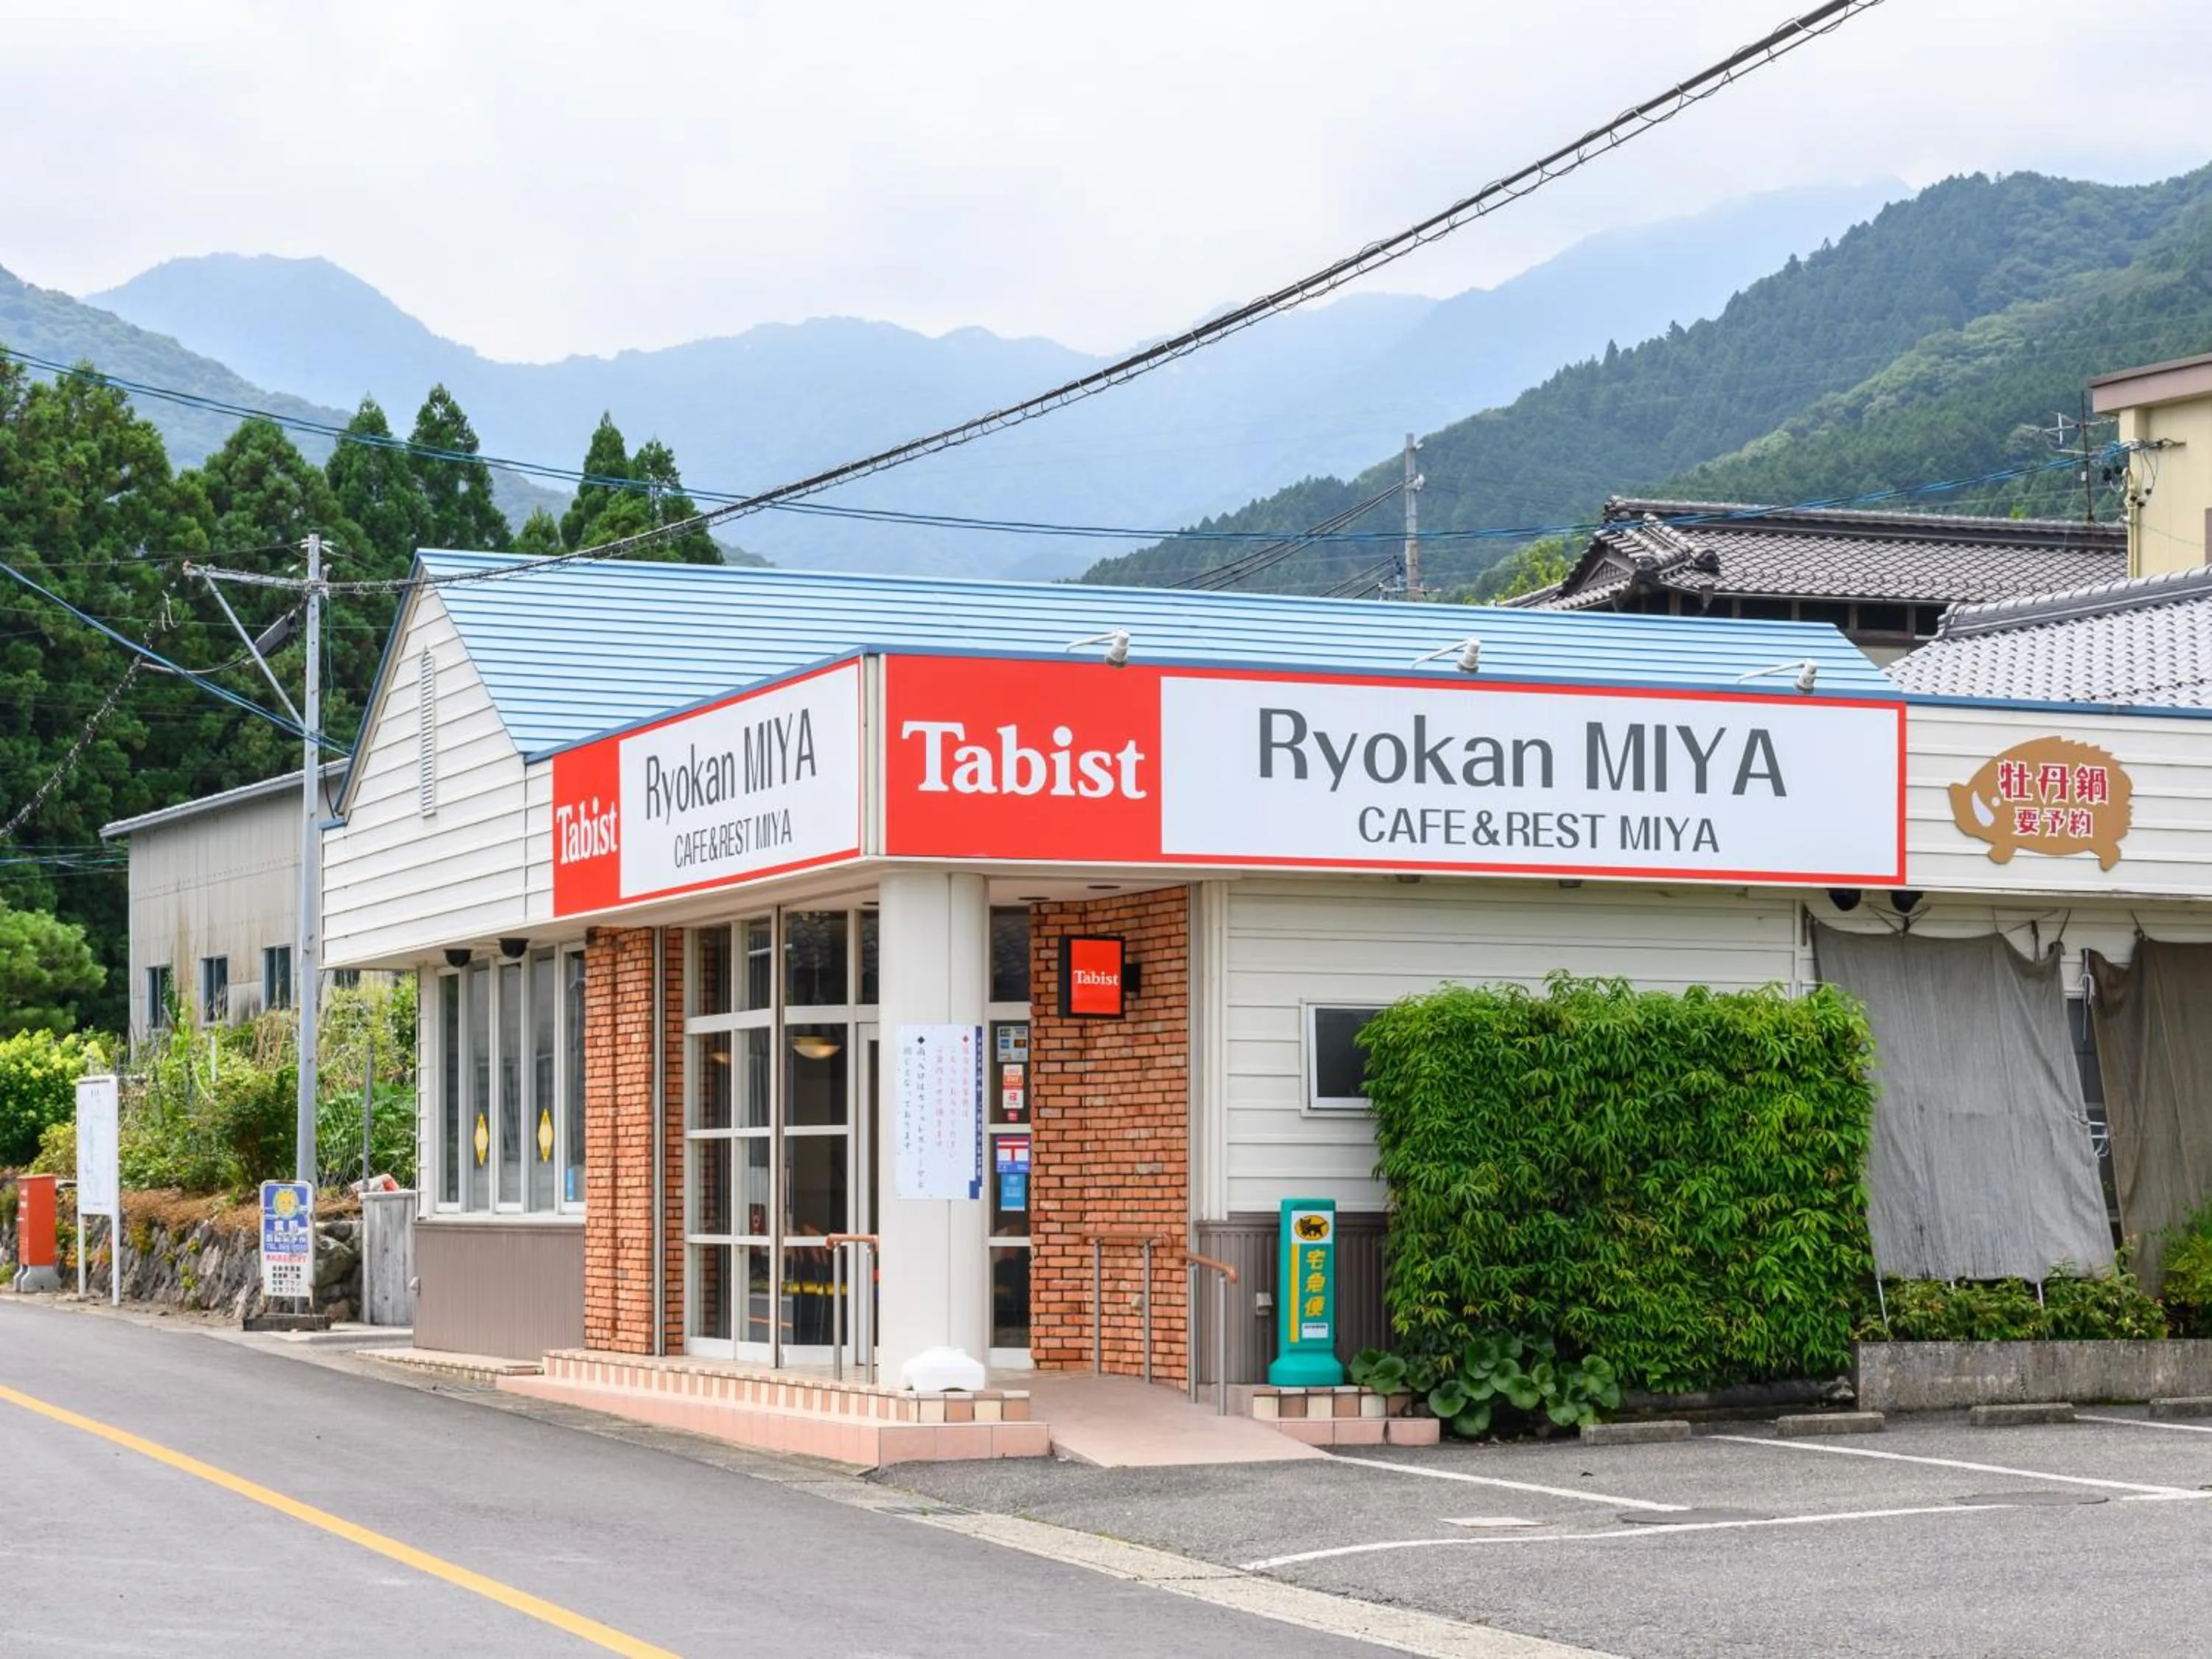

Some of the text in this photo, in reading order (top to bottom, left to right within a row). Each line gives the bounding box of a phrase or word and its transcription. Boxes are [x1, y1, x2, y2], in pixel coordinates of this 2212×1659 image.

[646, 708, 816, 825] Ryokan MIYA
[902, 720, 1147, 799] Tabist
[1259, 707, 1787, 797] Ryokan MIYA
[1998, 762, 2108, 803] 牡丹鍋
[557, 797, 618, 864] Tabist
[675, 809, 792, 868] CAFE&REST MIYA
[1359, 806, 1719, 853] CAFE&REST MIYA
[2014, 808, 2093, 837] 要予約
[1073, 970, 1119, 986] Tabist
[1304, 1249, 1326, 1318] 宅急便
